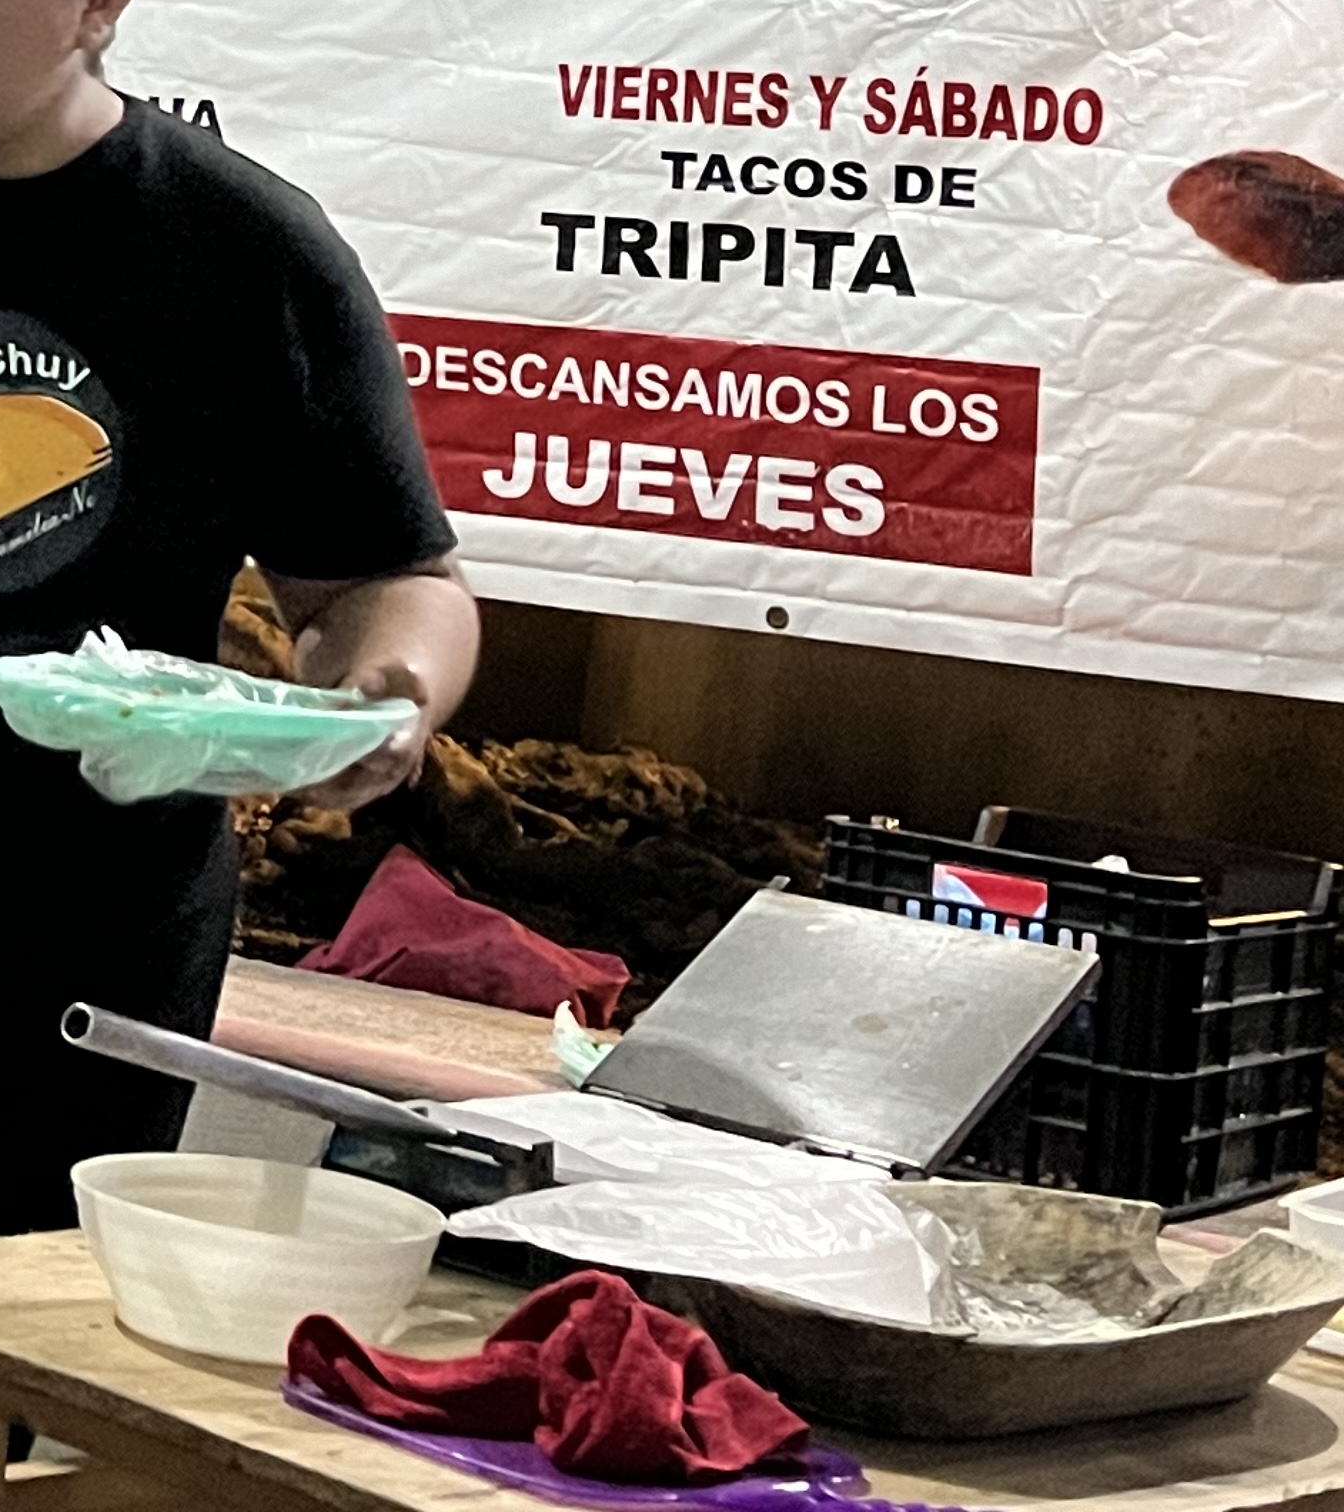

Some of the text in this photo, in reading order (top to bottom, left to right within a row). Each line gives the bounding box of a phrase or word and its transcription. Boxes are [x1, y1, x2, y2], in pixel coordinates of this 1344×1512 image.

[557, 64, 1104, 145] VIERNES Y SÁBADO
[660, 150, 977, 208] TACOS DE
[540, 212, 916, 298] TRIPITA
[397, 342, 1000, 442] DESCANSAMOS LOS
[482, 431, 887, 538] JUEVES
